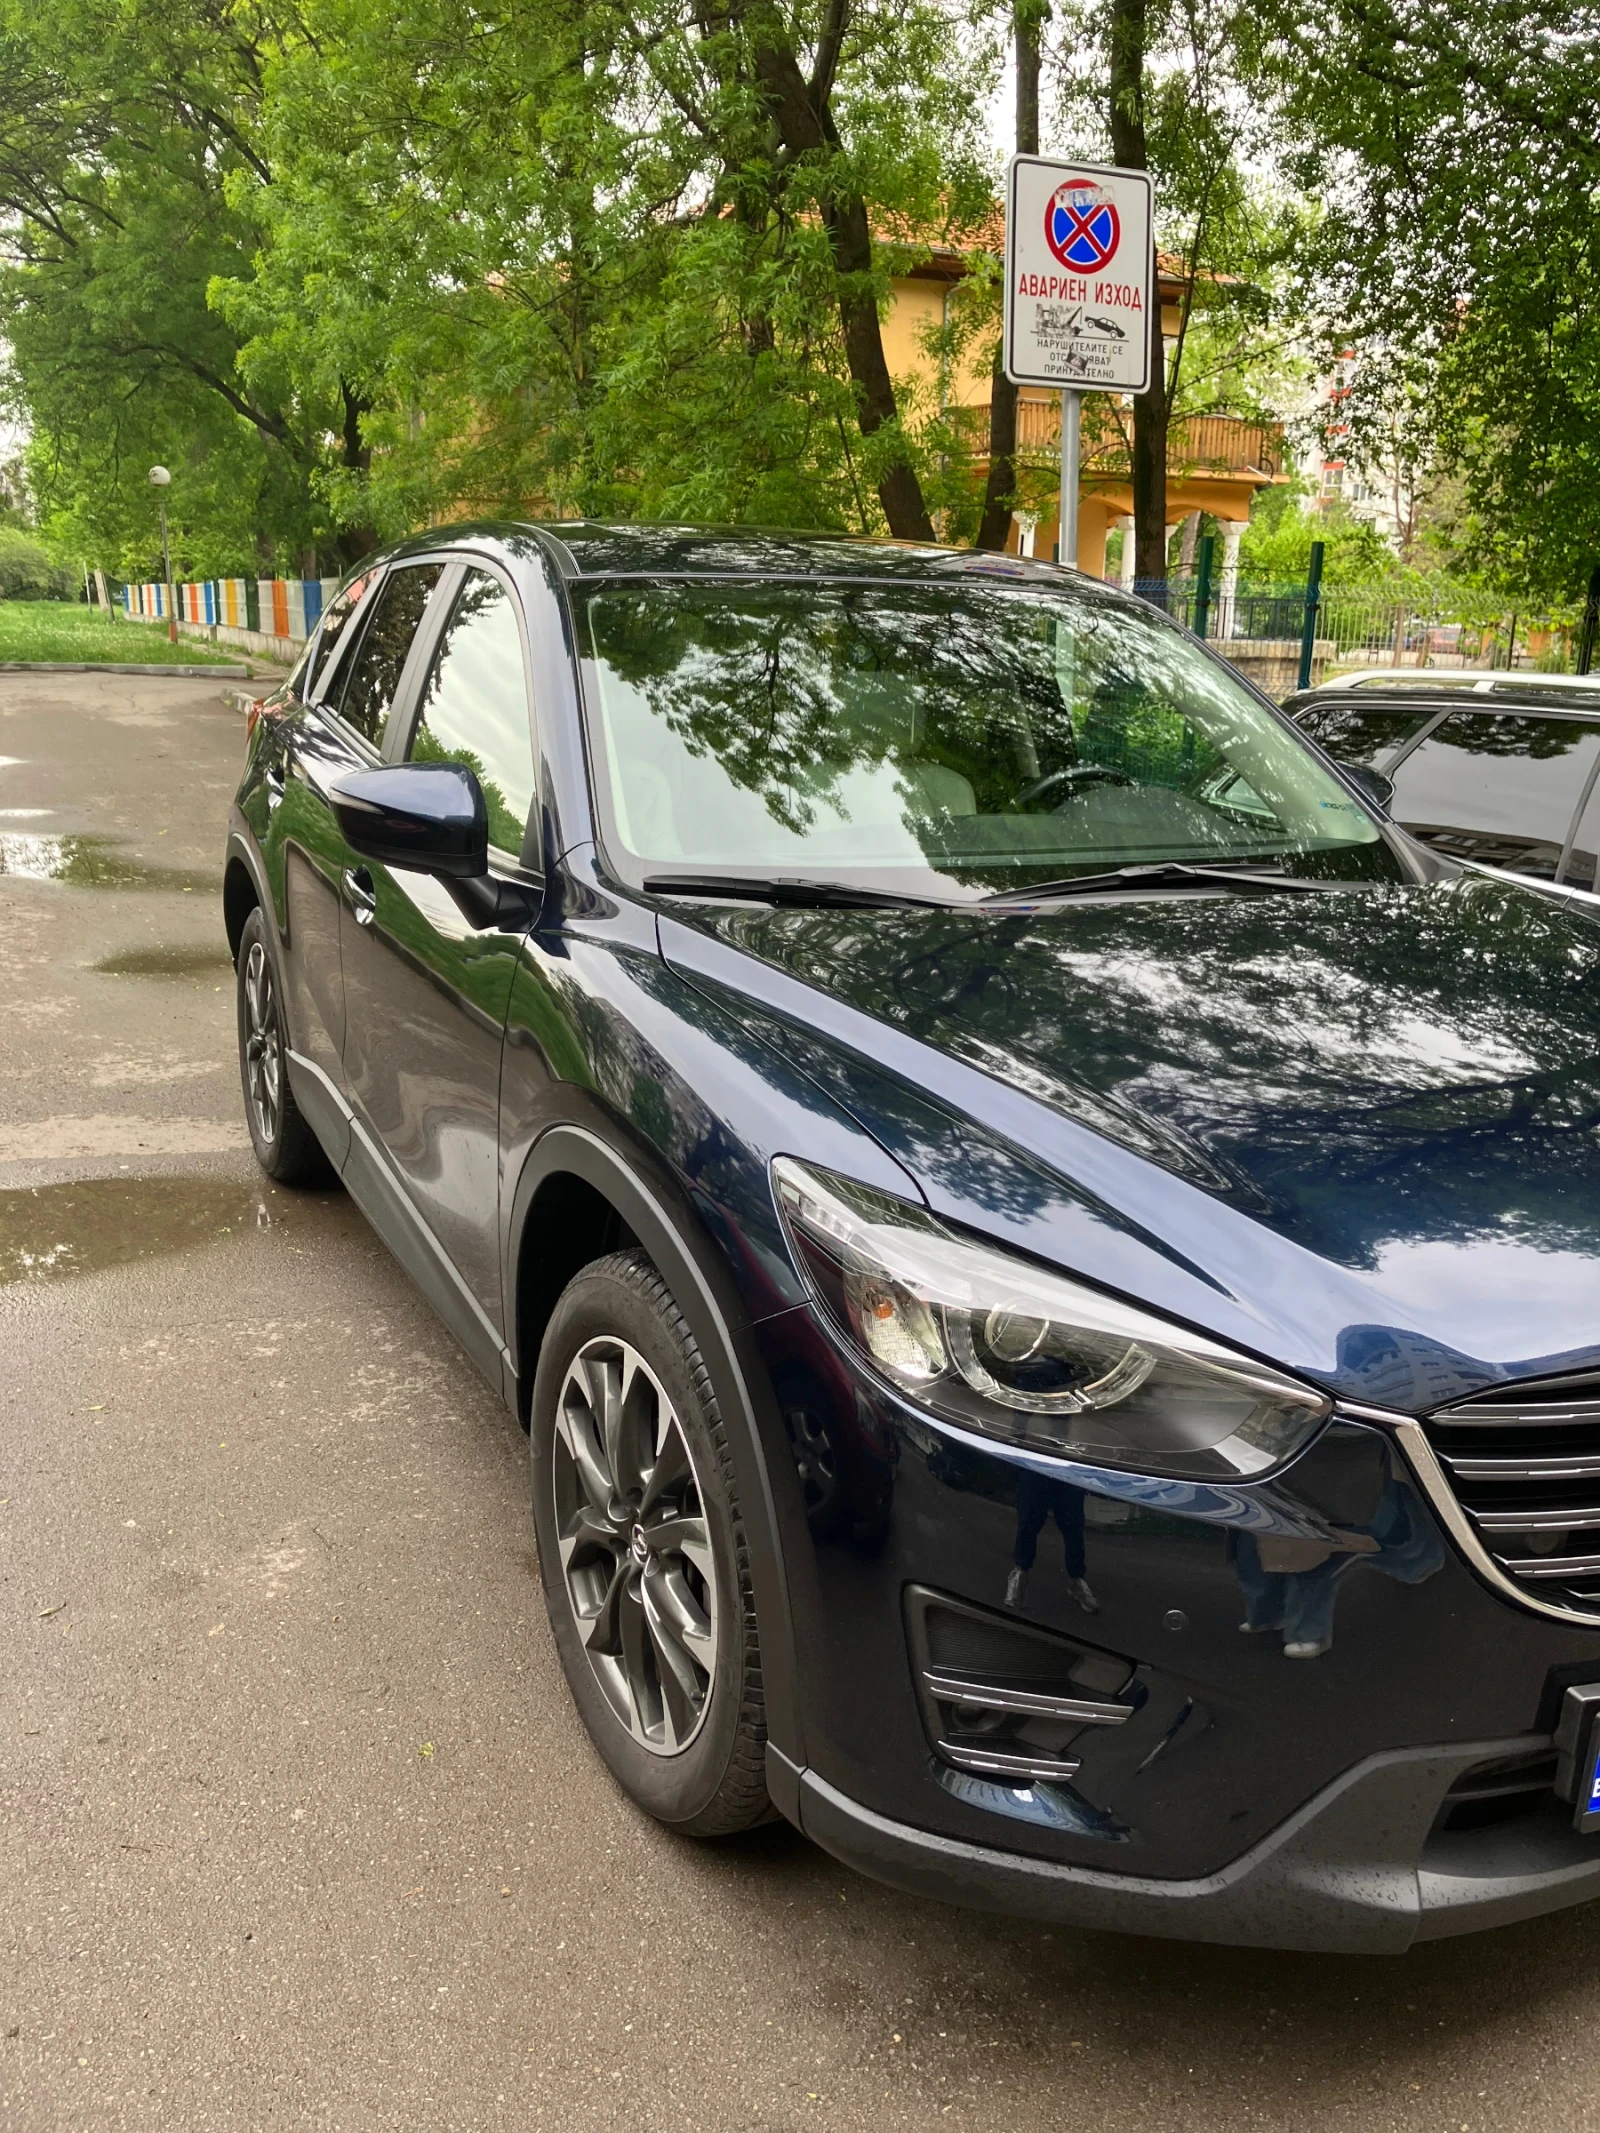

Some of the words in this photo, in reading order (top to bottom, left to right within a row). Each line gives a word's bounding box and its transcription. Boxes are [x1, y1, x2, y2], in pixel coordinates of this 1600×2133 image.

[1019, 273, 1087, 302] АВАРИЕН
[1095, 282, 1142, 312] ИЗХОД
[1037, 338, 1107, 354] НАРУШИТЕЛИТЕ
[1112, 345, 1123, 355] СЕ
[1050, 352, 1110, 366] ОТСЯВАТ
[1044, 364, 1114, 379] ПРИНУТЕЛНО
